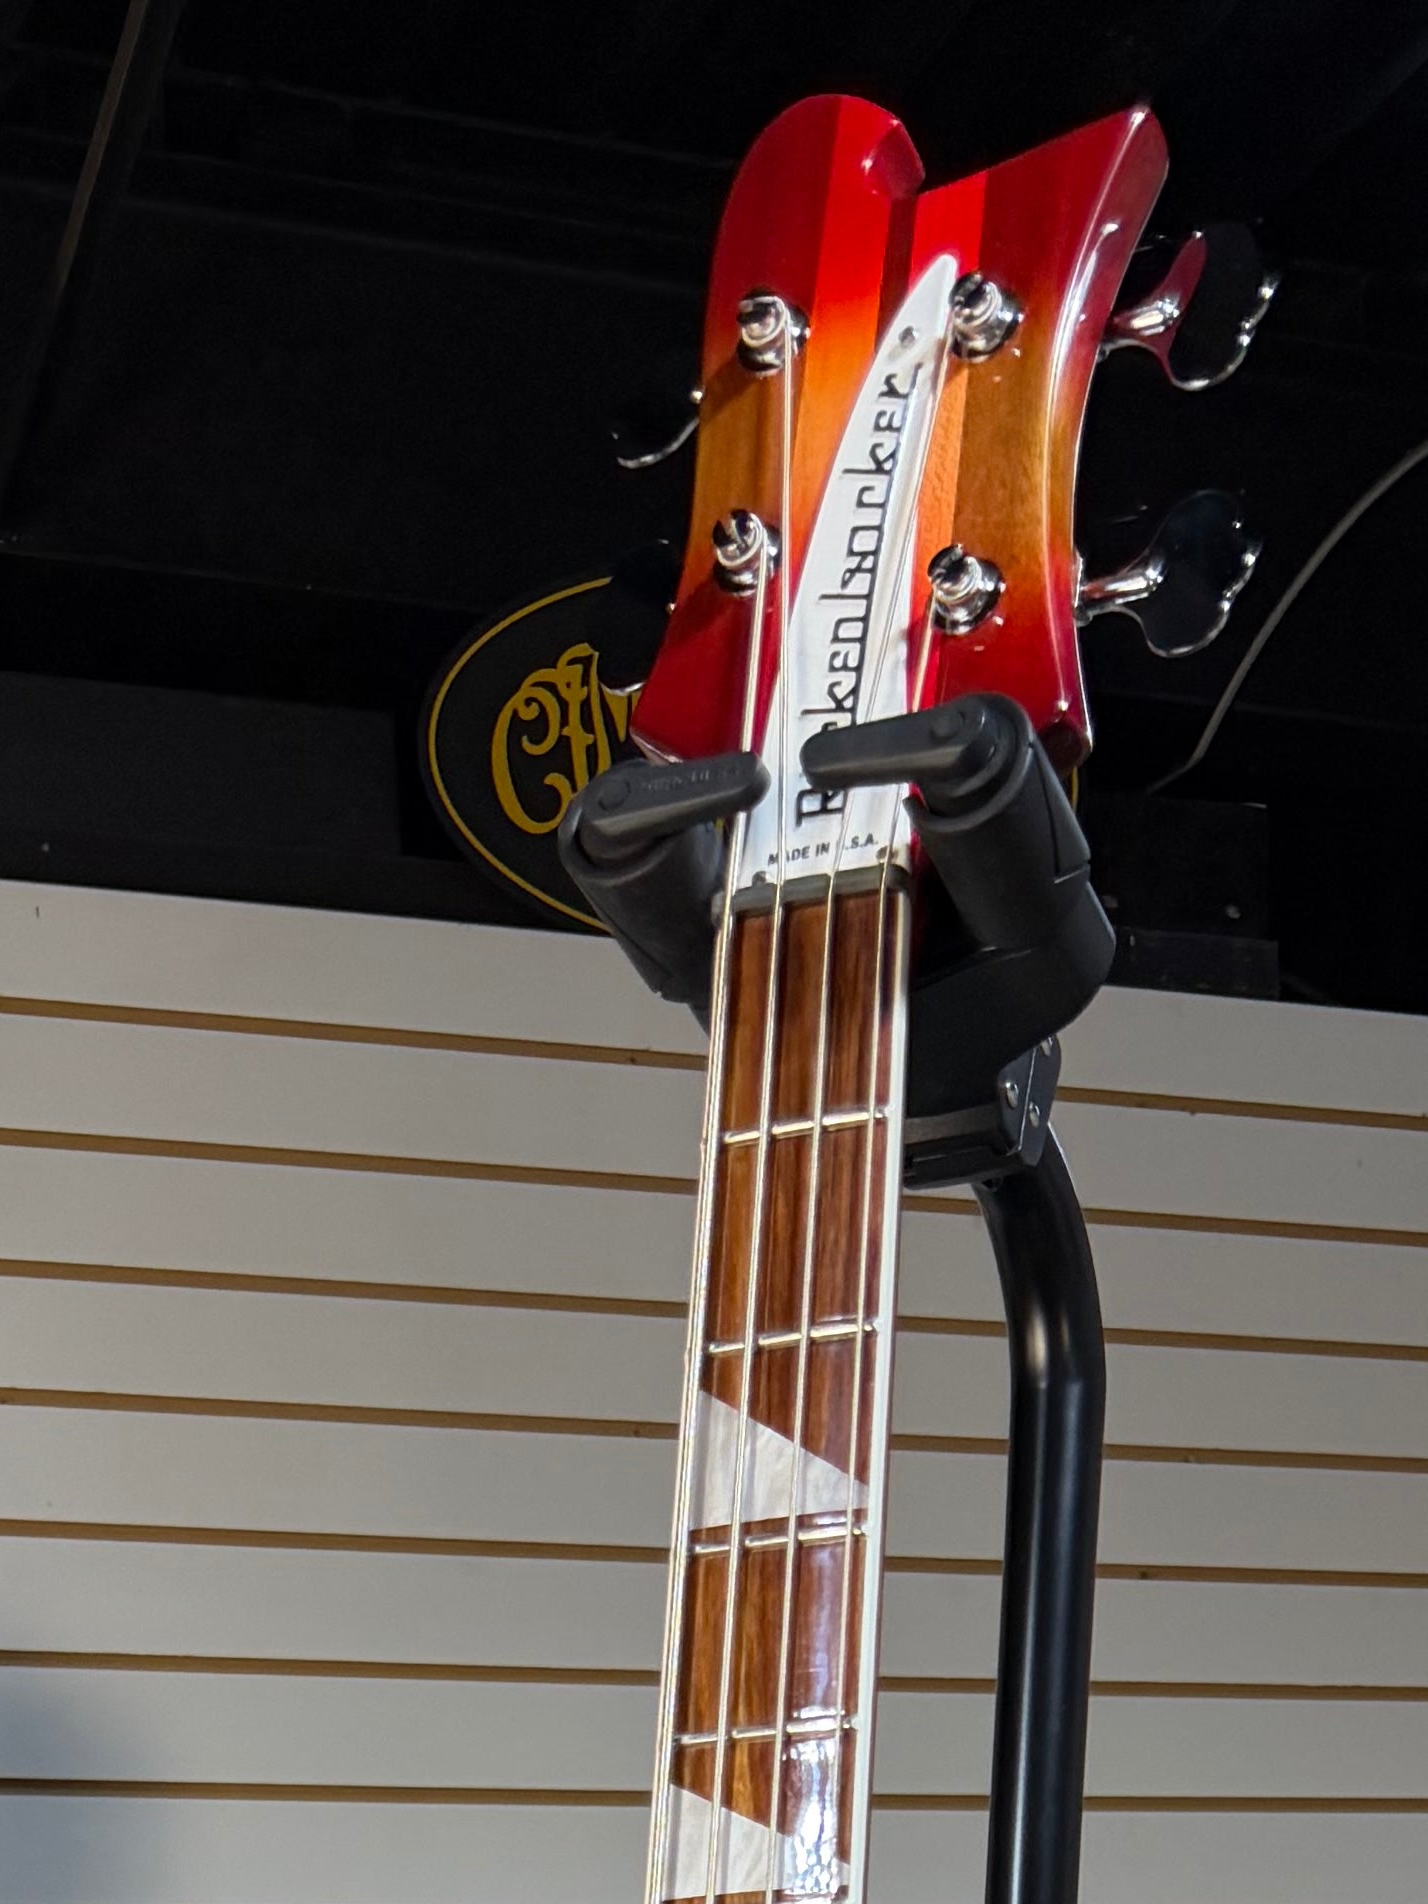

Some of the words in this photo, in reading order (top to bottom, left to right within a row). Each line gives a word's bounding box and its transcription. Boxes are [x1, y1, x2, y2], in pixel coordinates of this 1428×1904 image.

[795, 361, 925, 829] Rkenbacker
[815, 842, 831, 857] IN
[835, 832, 880, 858] .S.A.
